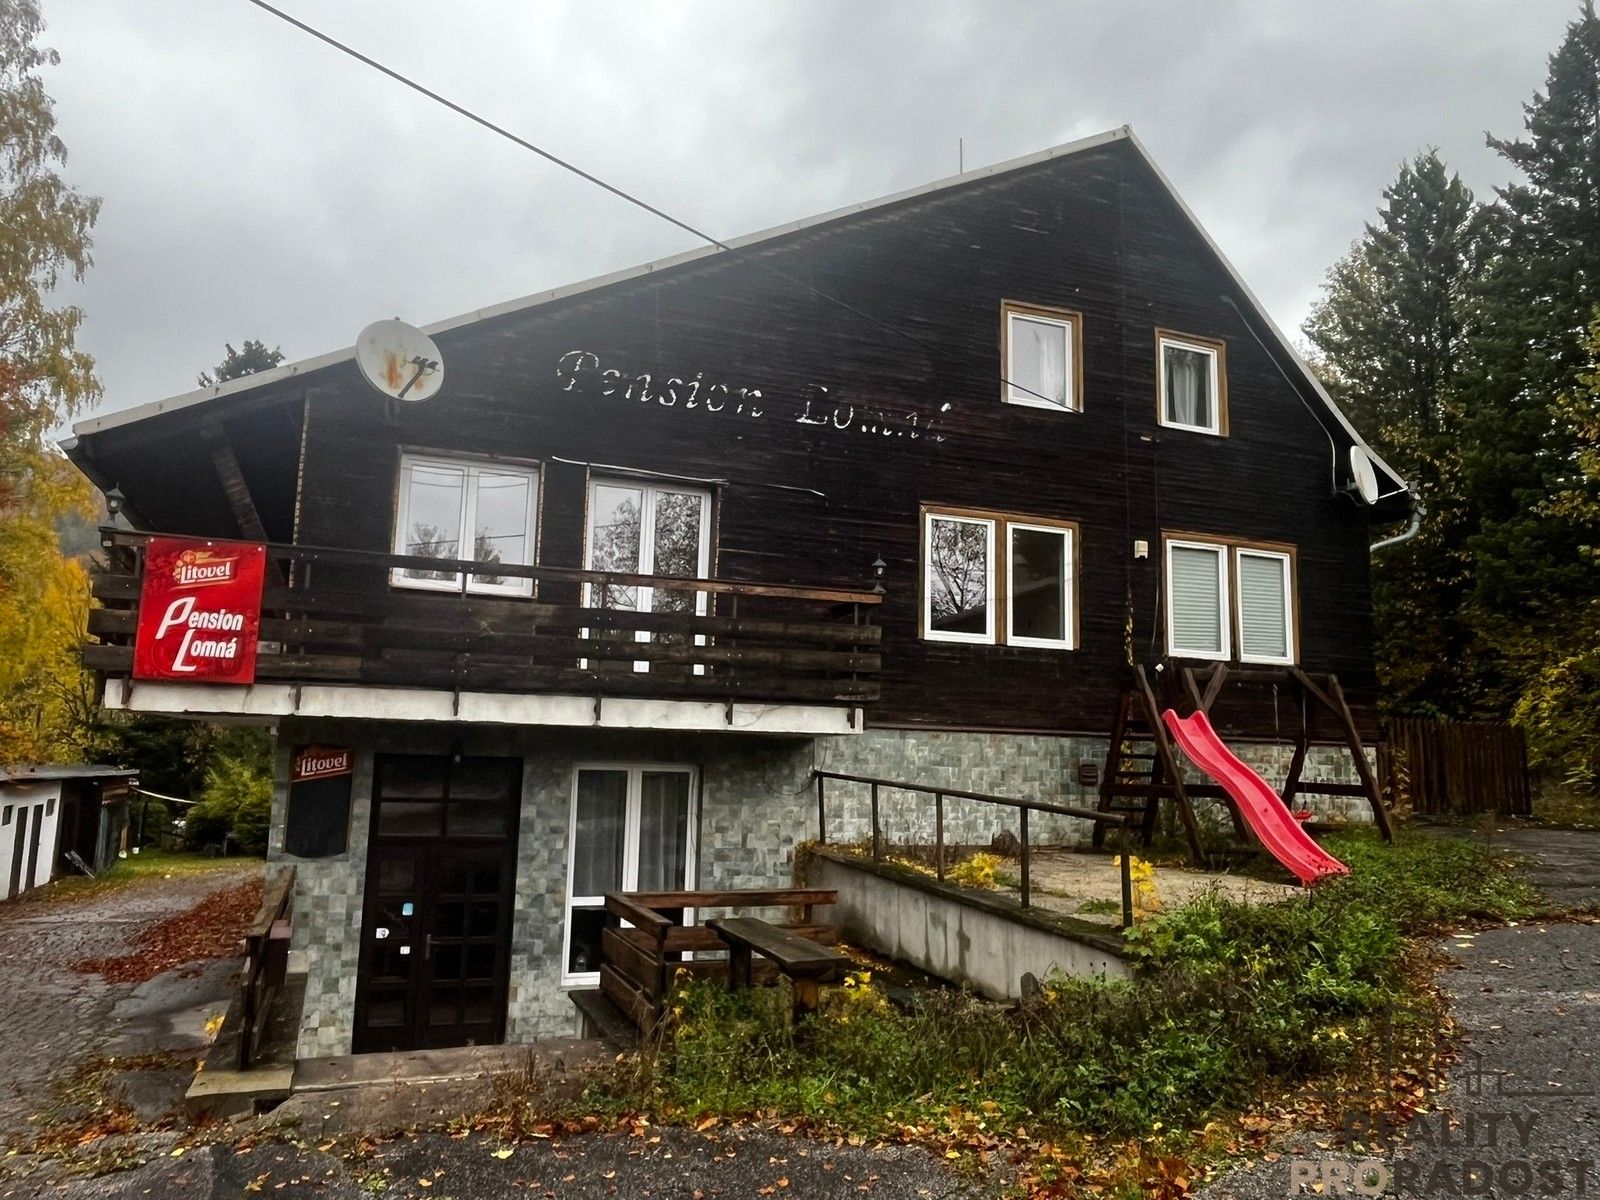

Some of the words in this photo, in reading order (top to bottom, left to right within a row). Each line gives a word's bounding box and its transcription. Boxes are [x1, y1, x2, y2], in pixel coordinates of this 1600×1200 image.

[180, 562, 230, 584] Litovel
[155, 597, 244, 640] Pension
[171, 629, 237, 672] Lomná
[301, 752, 347, 776] Litovel
